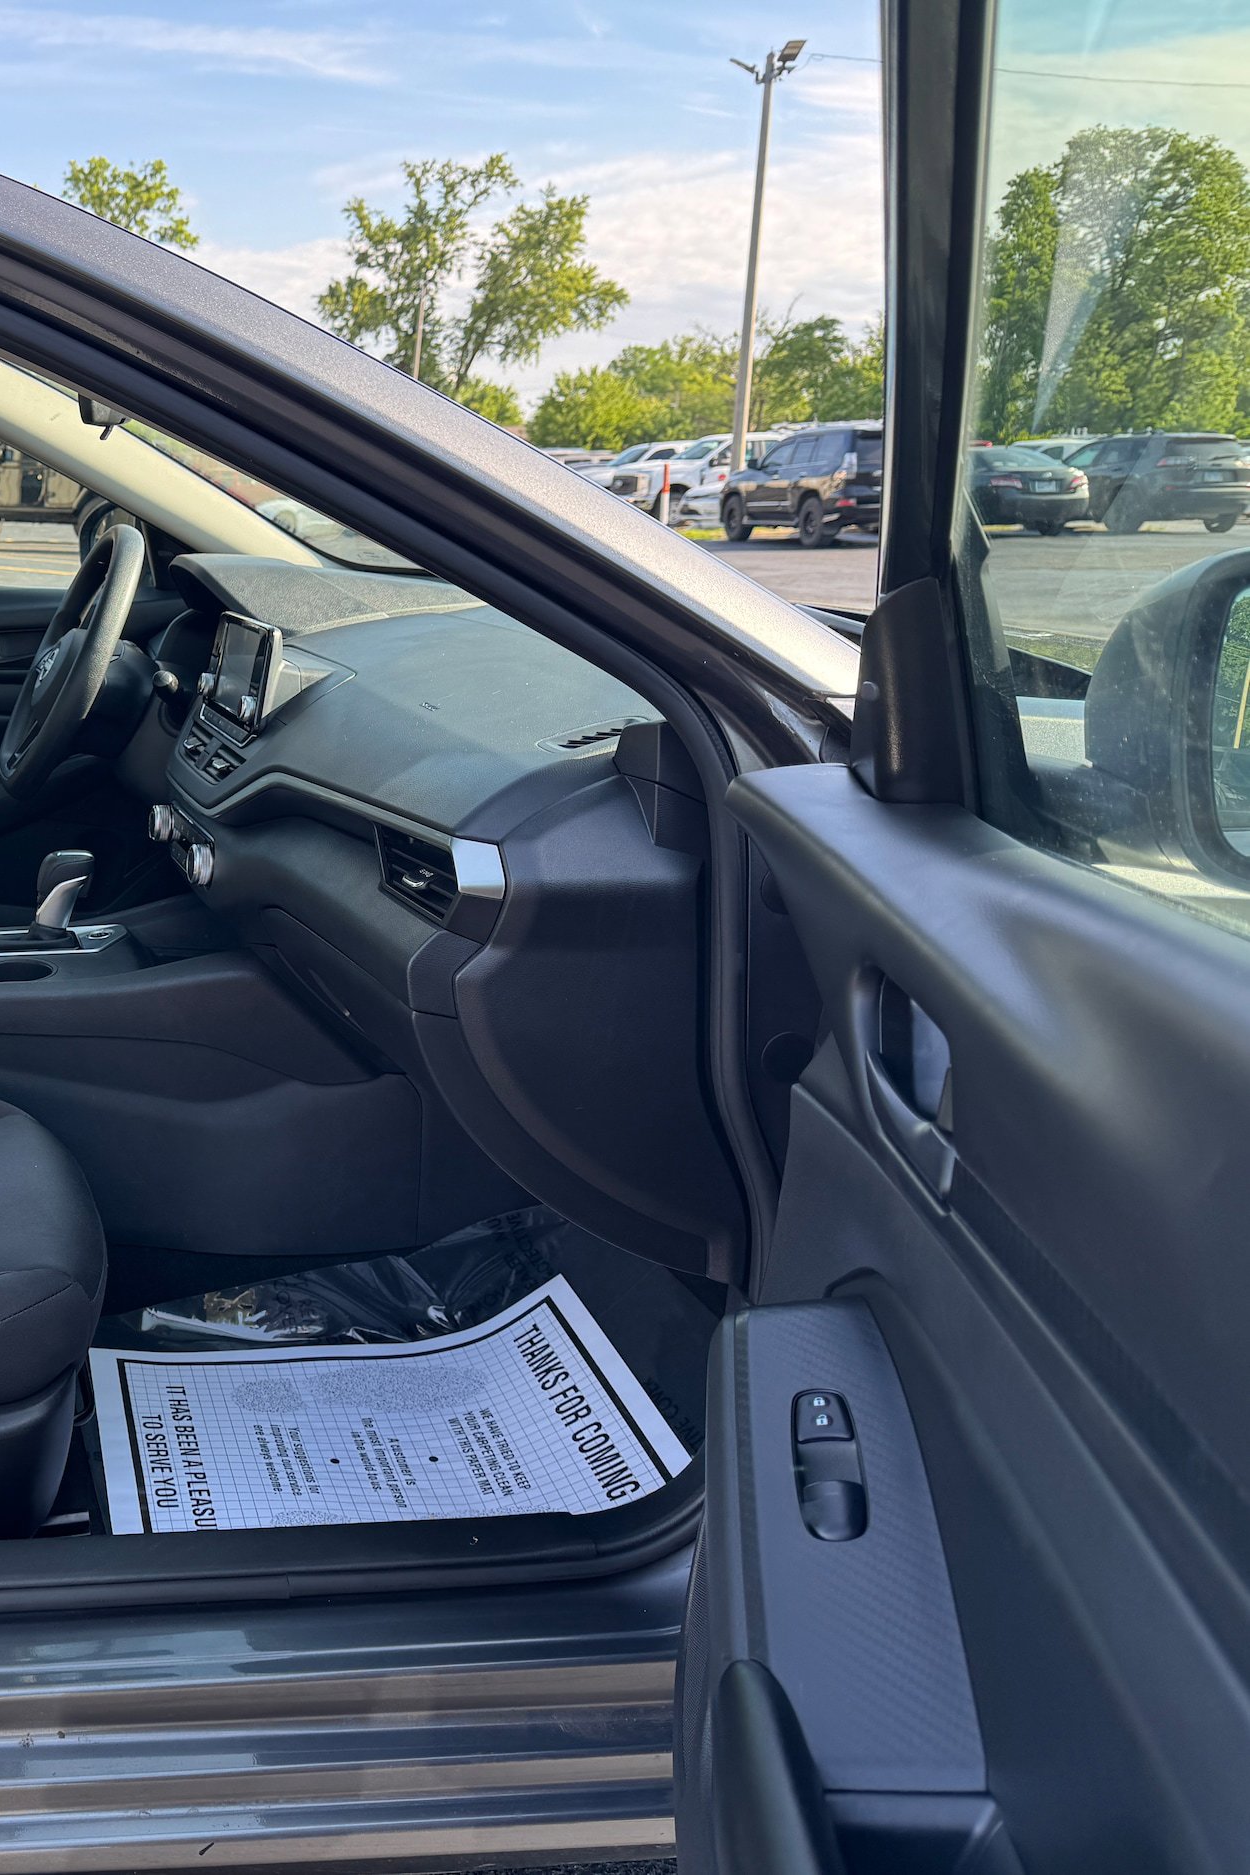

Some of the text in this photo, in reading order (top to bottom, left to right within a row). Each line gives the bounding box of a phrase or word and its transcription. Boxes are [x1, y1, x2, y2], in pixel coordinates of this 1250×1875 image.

[353, 1439, 366, 1451] the
[479, 1408, 532, 1490] WE HAVE TRIED TO KEEP
[513, 1323, 641, 1502] THANKS FOR COMING
[141, 1414, 180, 1508] TO SERVE YOU
[165, 1386, 218, 1529] IT HAS BEEN A PLEASU
[257, 1437, 272, 1460] always
[265, 1462, 283, 1495] welcome.
[270, 1424, 302, 1496] improving our service
[288, 1427, 320, 1494] Your suggestions for
[359, 1452, 377, 1472] world
[361, 1417, 408, 1508] the most important person
[390, 1444, 413, 1477] customer
[405, 1478, 416, 1486] is
[448, 1417, 495, 1496] WITH THIS PAPER MAT
[463, 1411, 515, 1497] YOUR CARPETING CLEAN
